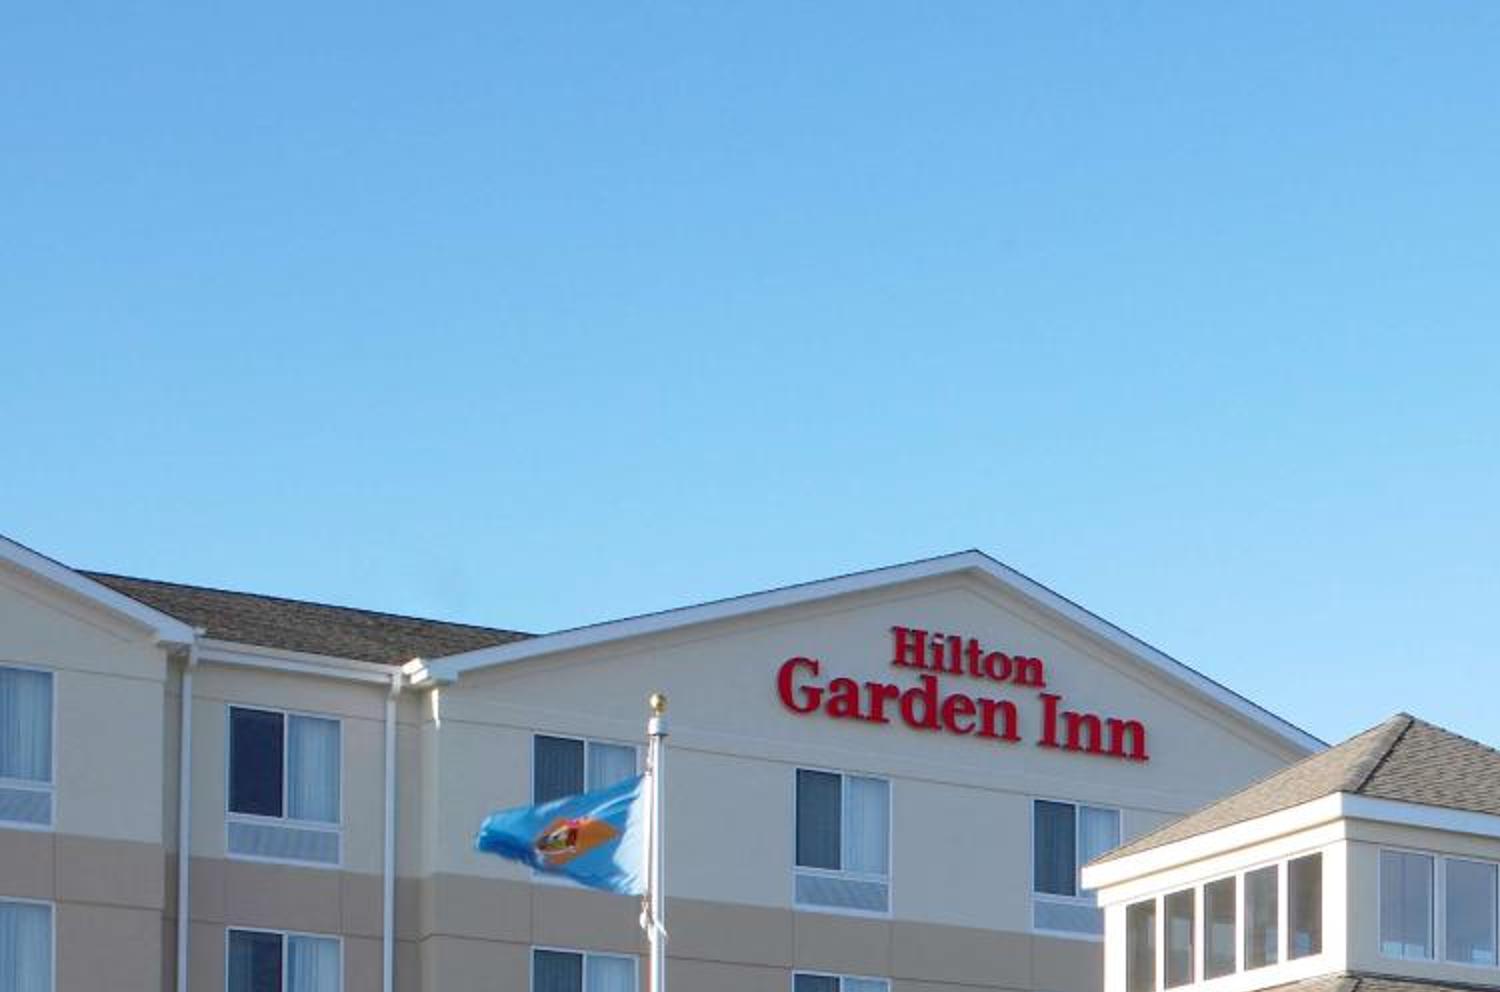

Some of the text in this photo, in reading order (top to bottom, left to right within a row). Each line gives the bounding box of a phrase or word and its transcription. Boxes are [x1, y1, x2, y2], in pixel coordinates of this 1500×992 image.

[890, 626, 1046, 688] Hilton
[777, 656, 1150, 761] Garden Inn
